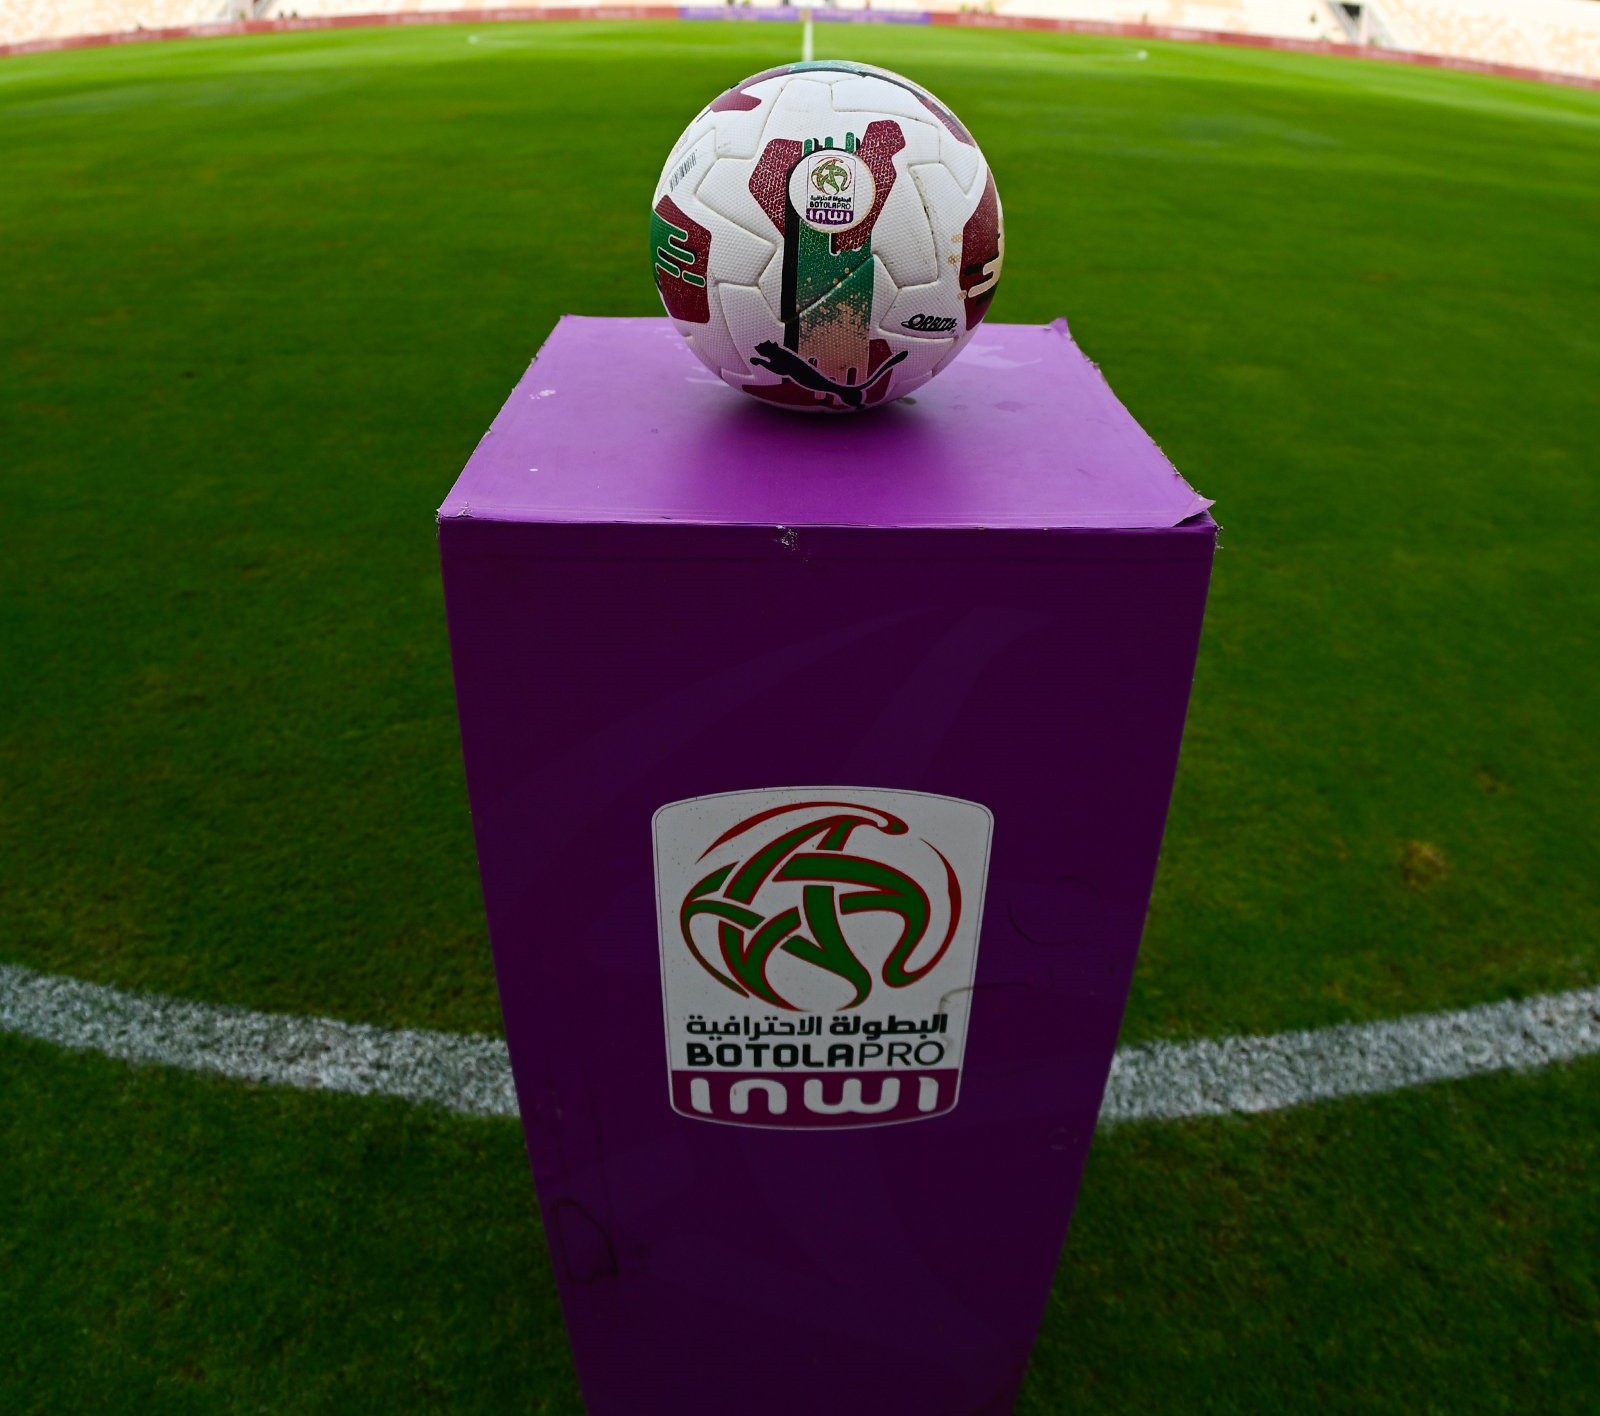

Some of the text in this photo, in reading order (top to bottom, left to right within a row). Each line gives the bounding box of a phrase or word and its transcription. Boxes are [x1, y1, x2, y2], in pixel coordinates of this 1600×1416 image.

[810, 202, 851, 210] BOTOLAPRO
[685, 1013, 948, 1041] البطولة الاحترافية
[686, 1041, 946, 1068] BOTOLAPRO
